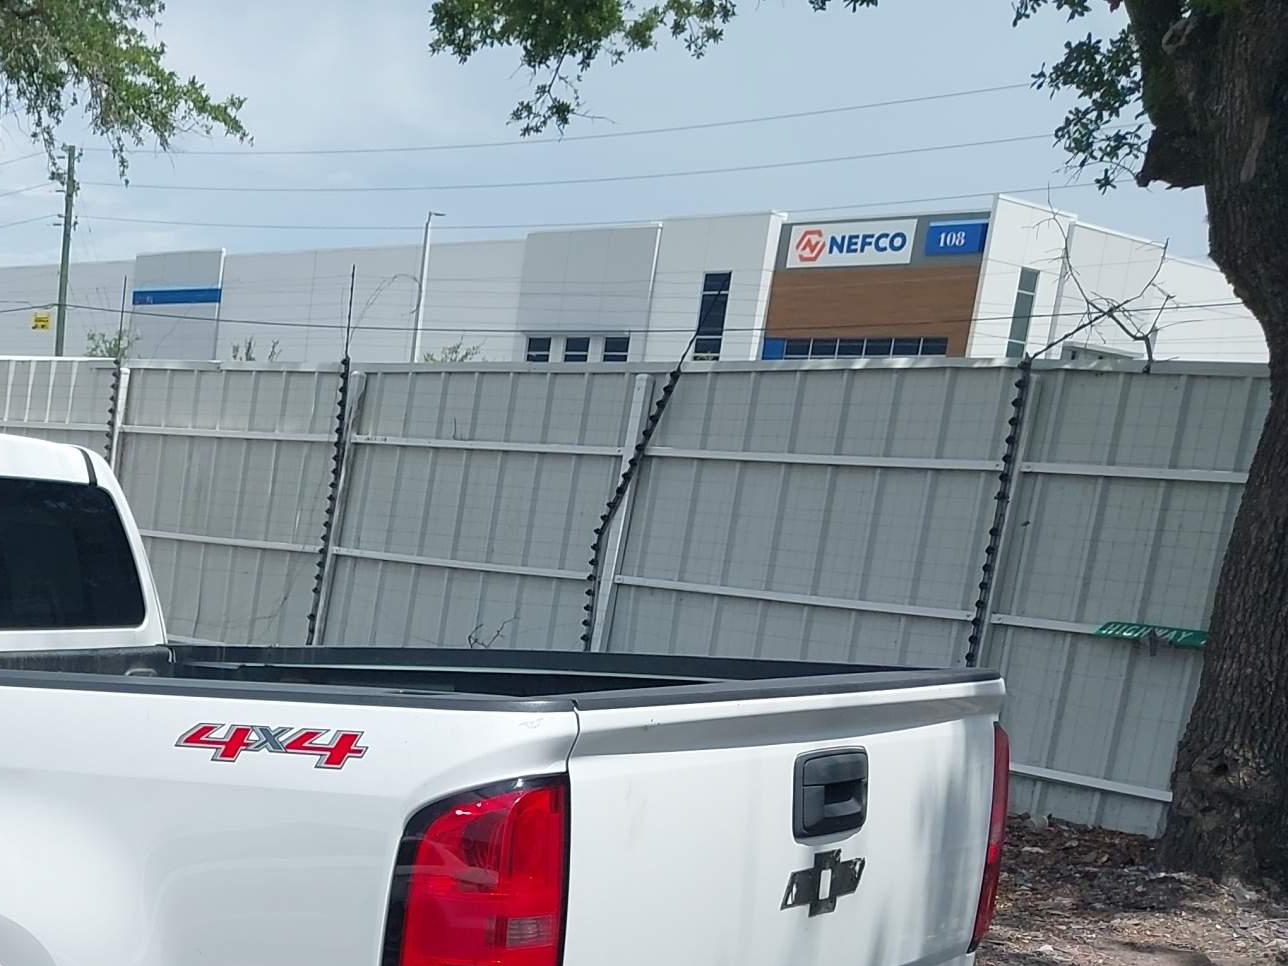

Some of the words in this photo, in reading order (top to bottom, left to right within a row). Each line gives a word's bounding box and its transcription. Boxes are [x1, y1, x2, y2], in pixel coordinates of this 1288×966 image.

[828, 231, 907, 254] NEFCO
[938, 231, 966, 247] 108
[1101, 623, 1193, 642] HIGHWAY
